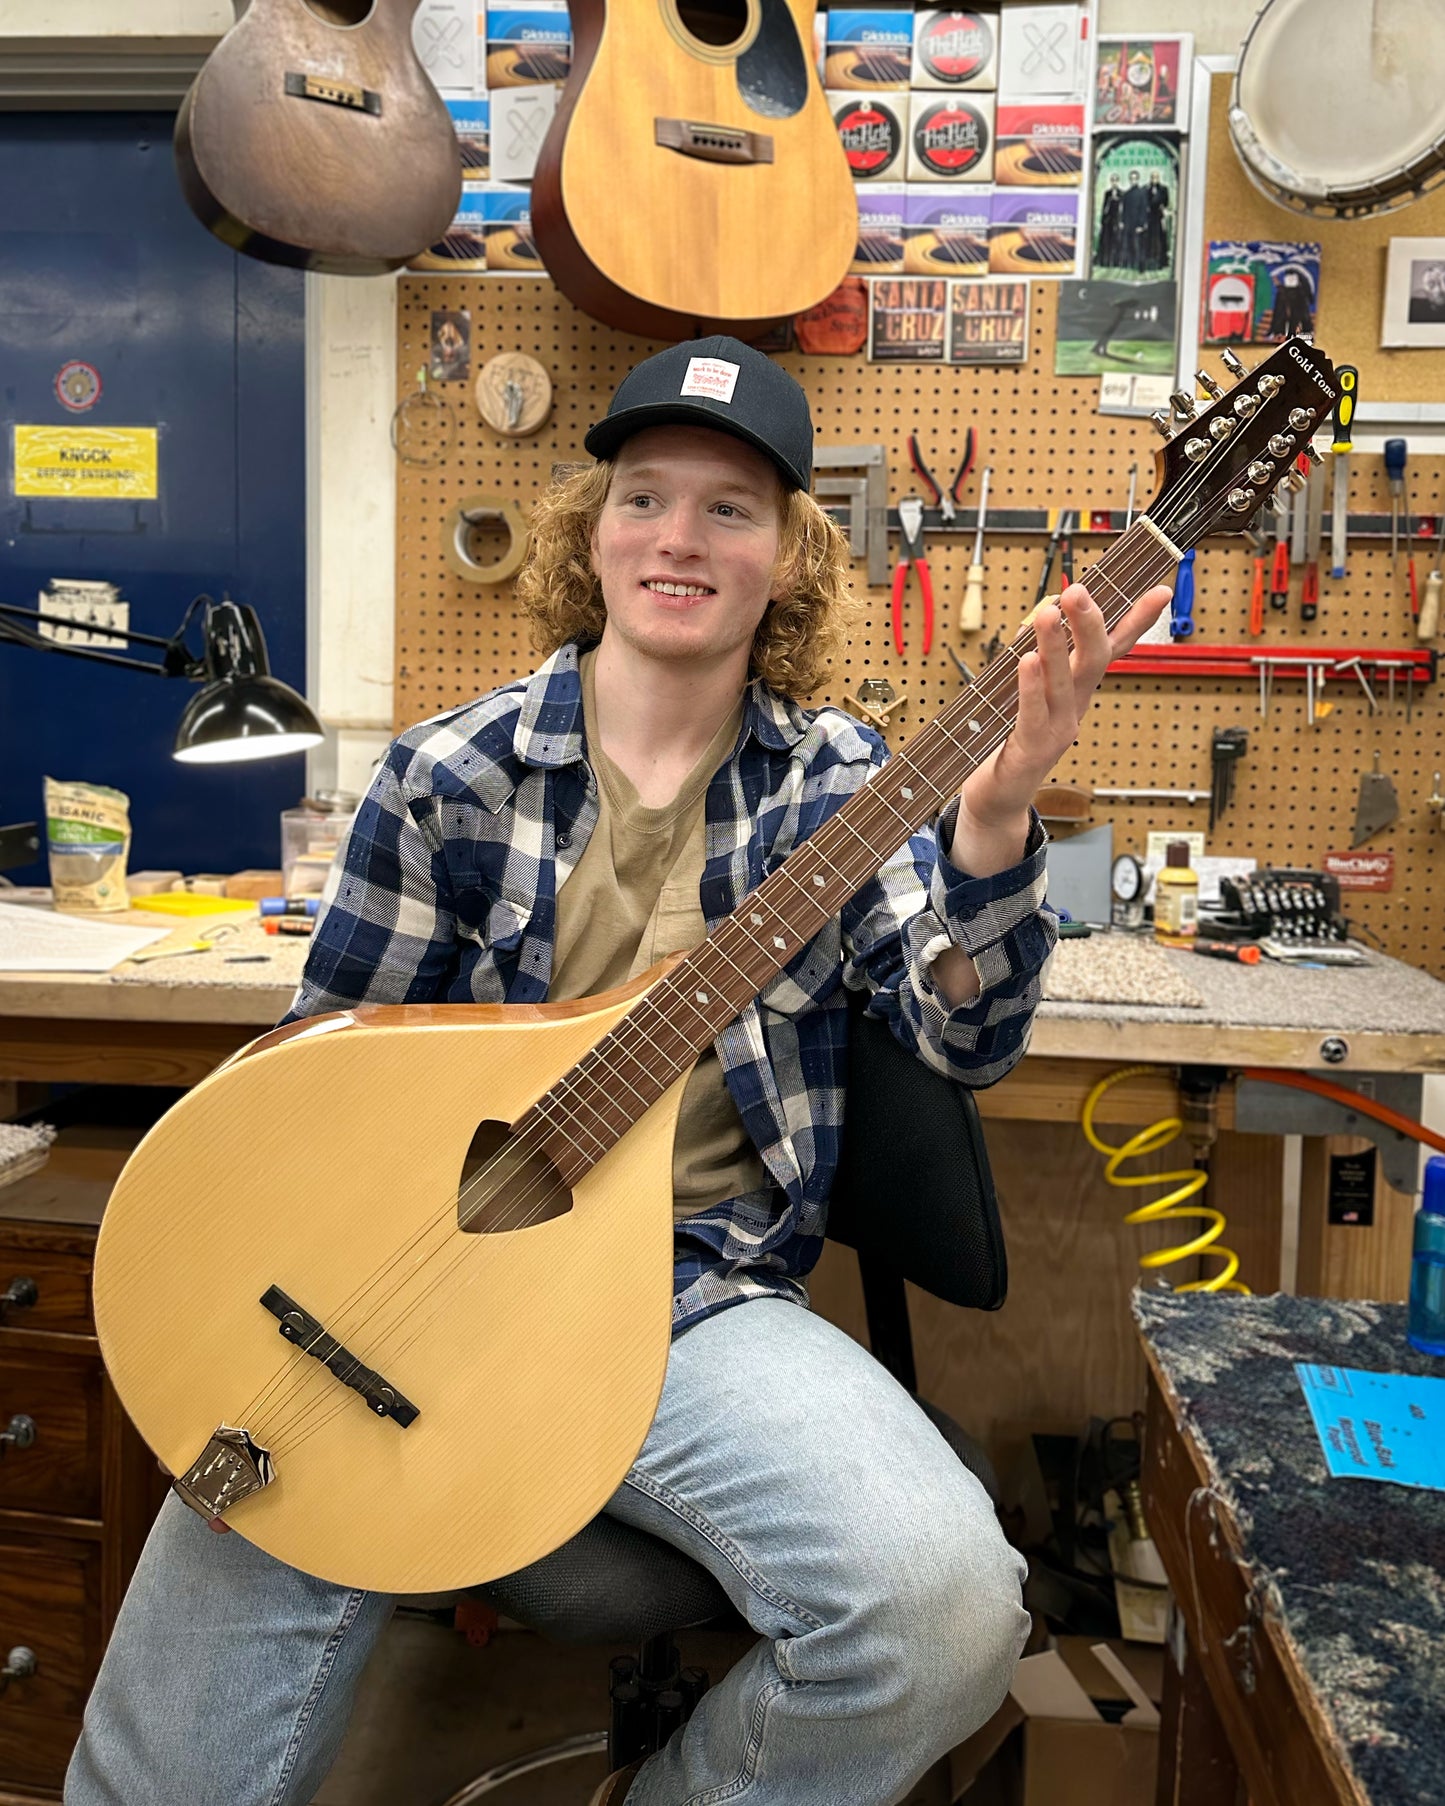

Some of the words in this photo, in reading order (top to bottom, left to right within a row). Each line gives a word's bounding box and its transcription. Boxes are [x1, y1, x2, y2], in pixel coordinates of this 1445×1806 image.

[875, 281, 945, 309] SANTA
[952, 284, 1024, 313] SANTA
[886, 313, 944, 341] CRUZ
[965, 317, 1024, 342] CRUZ
[1288, 346, 1314, 374] Gold
[1311, 370, 1336, 399] Tone
[60, 448, 112, 463] KNOCK
[37, 467, 77, 479] BEFORE
